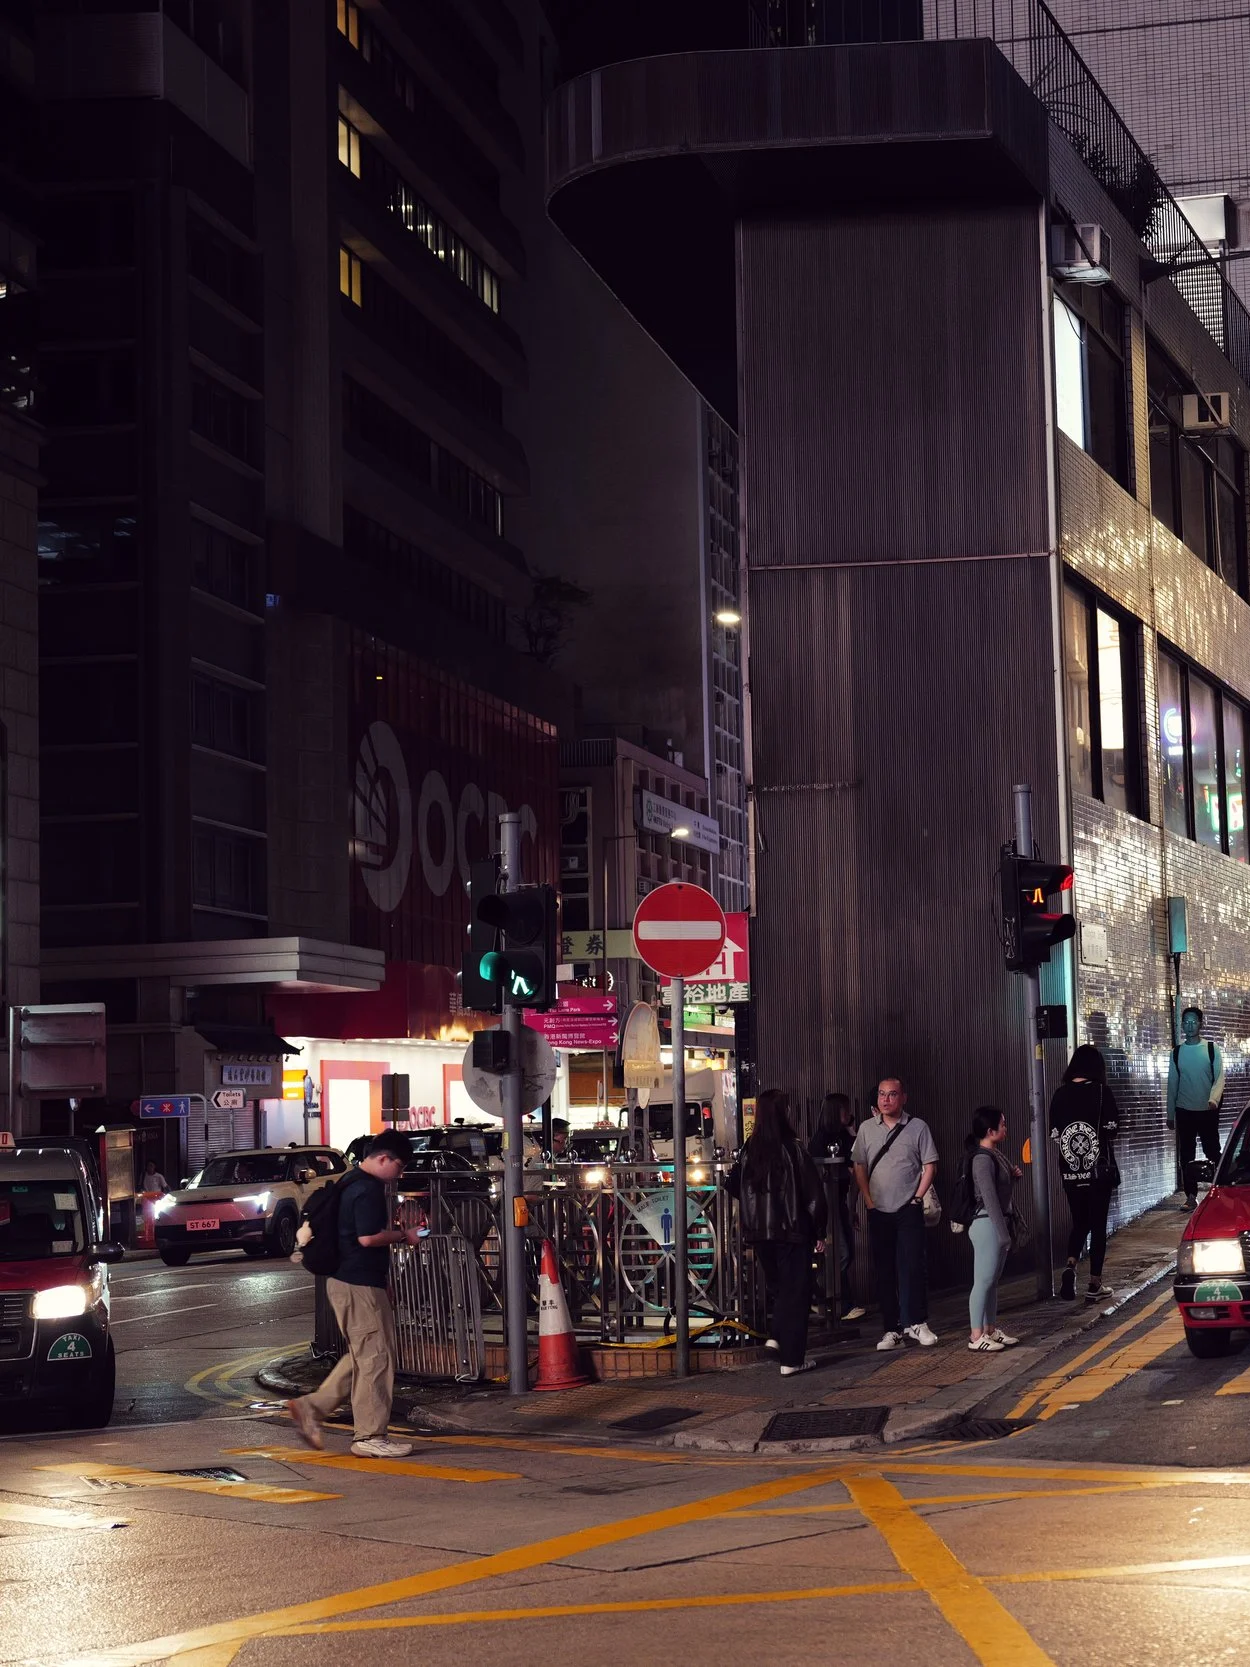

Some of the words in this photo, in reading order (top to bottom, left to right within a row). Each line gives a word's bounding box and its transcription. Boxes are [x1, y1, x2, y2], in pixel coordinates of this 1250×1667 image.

[190, 1221, 200, 1229] ST
[201, 1220, 216, 1228] 667
[1213, 1287, 1221, 1295] 4
[66, 1341, 76, 1352] 4
